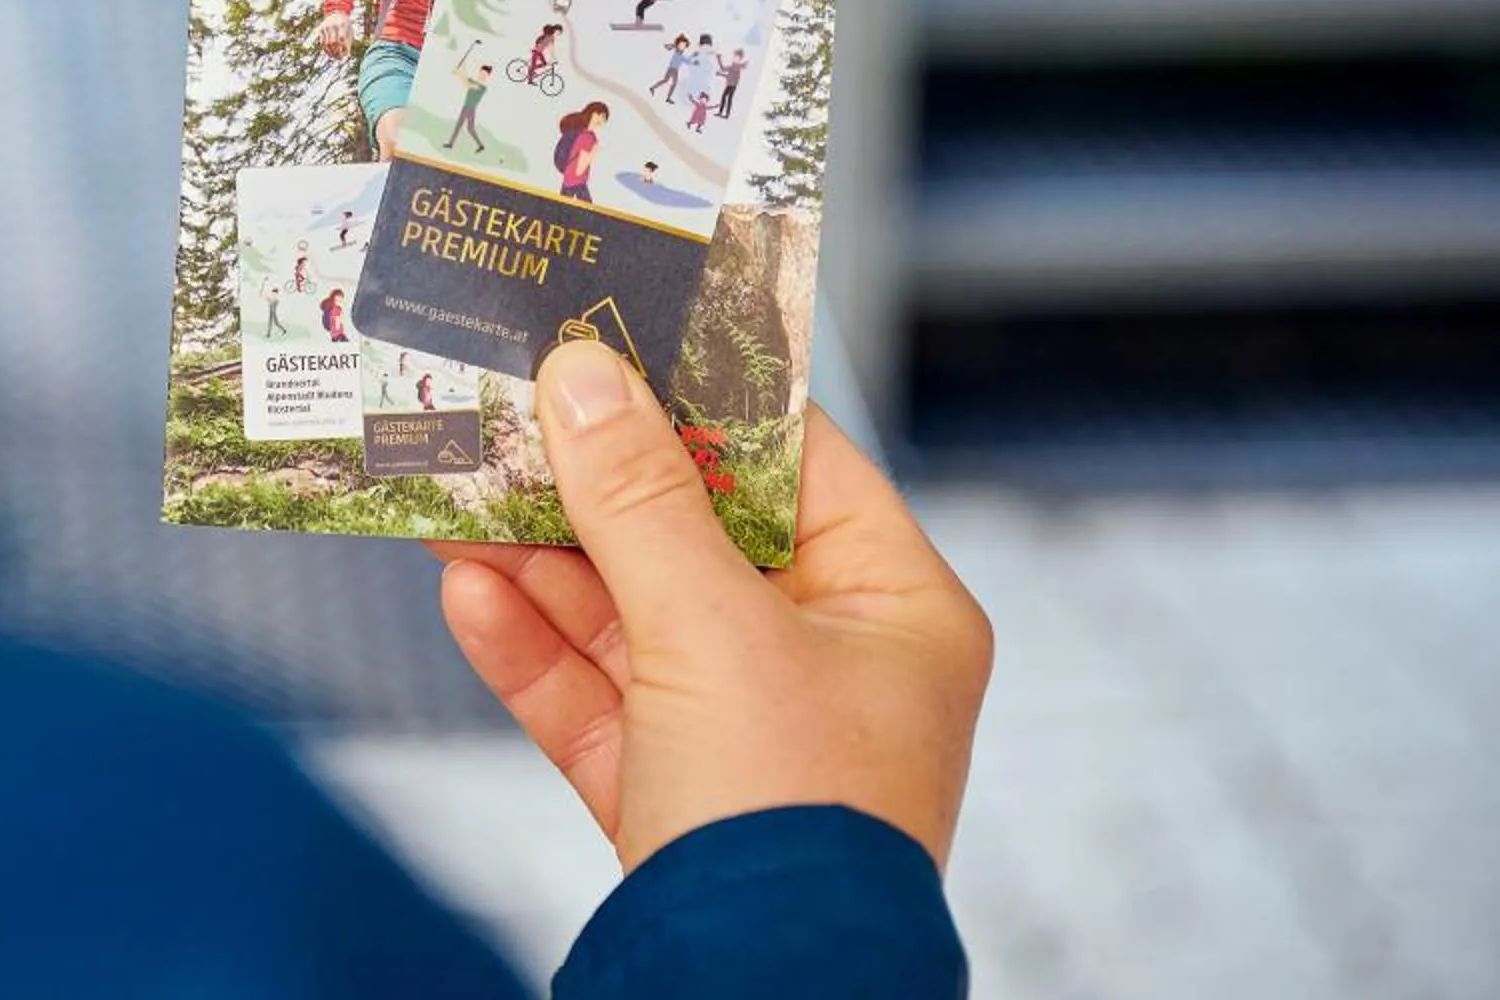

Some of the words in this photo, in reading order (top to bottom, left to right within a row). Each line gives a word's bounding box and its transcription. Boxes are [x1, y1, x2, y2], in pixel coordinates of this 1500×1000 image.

[401, 221, 549, 284] PREMIUM
[411, 187, 602, 263] GÄSTEKARTE
[385, 295, 529, 342] www.gaestekarte.at
[265, 353, 360, 373] GÄSTEKART
